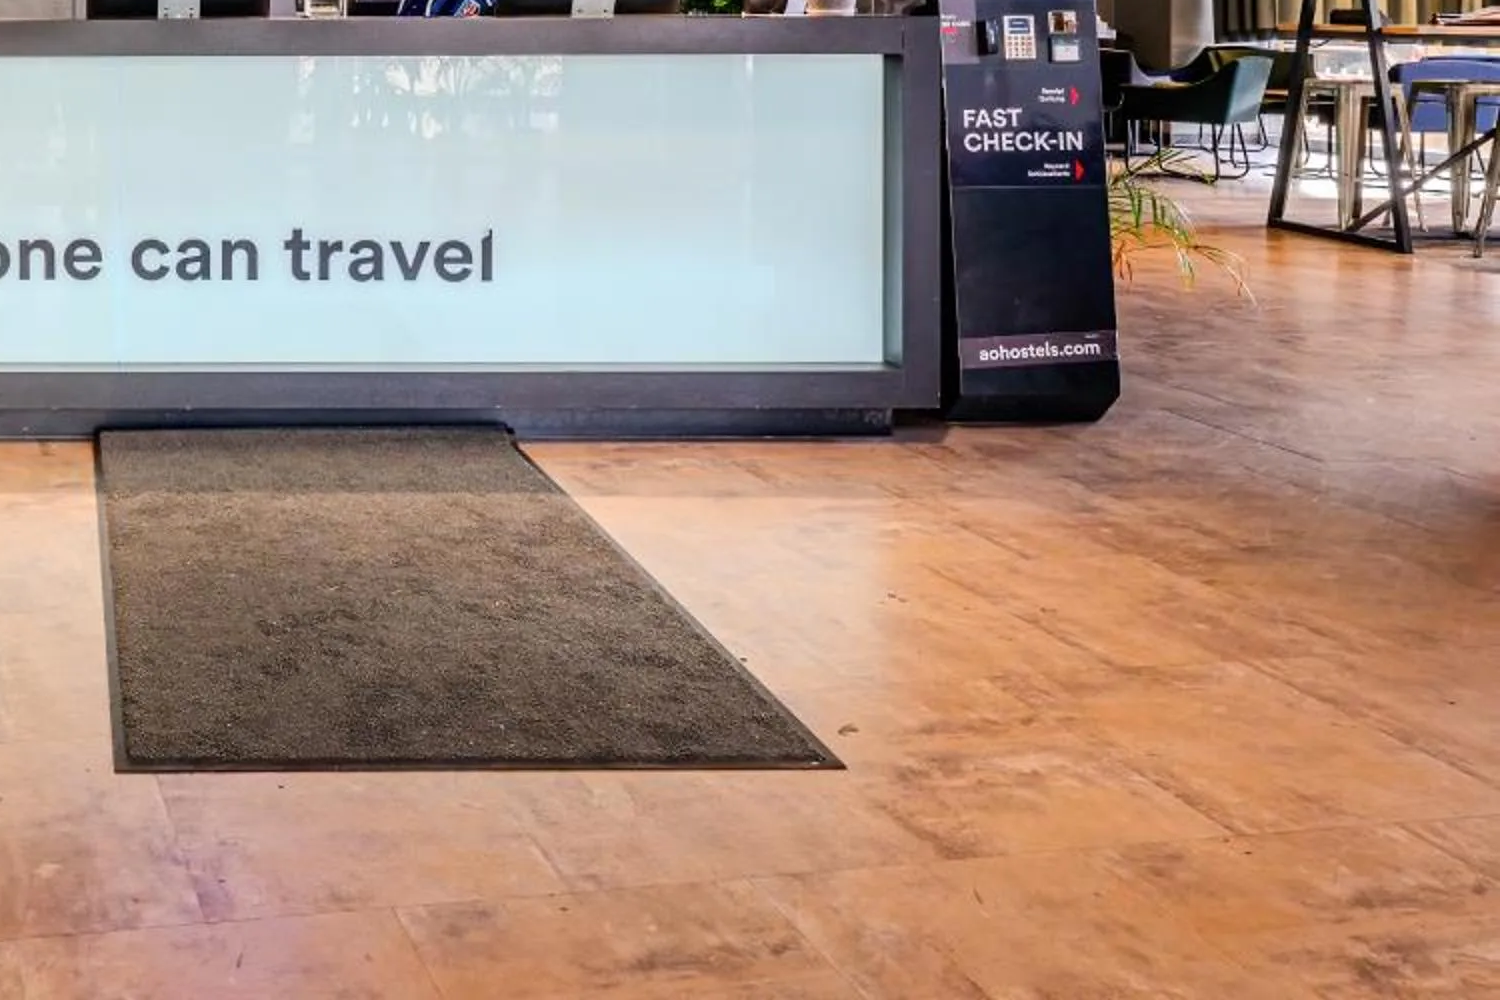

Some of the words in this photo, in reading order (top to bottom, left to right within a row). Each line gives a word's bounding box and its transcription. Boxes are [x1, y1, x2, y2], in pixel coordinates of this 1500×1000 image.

[963, 107, 1022, 129] FAST
[963, 130, 1083, 152] CHECK-IN
[131, 238, 259, 281] can
[283, 228, 493, 282] travel
[979, 340, 1101, 361] aohostels.com
